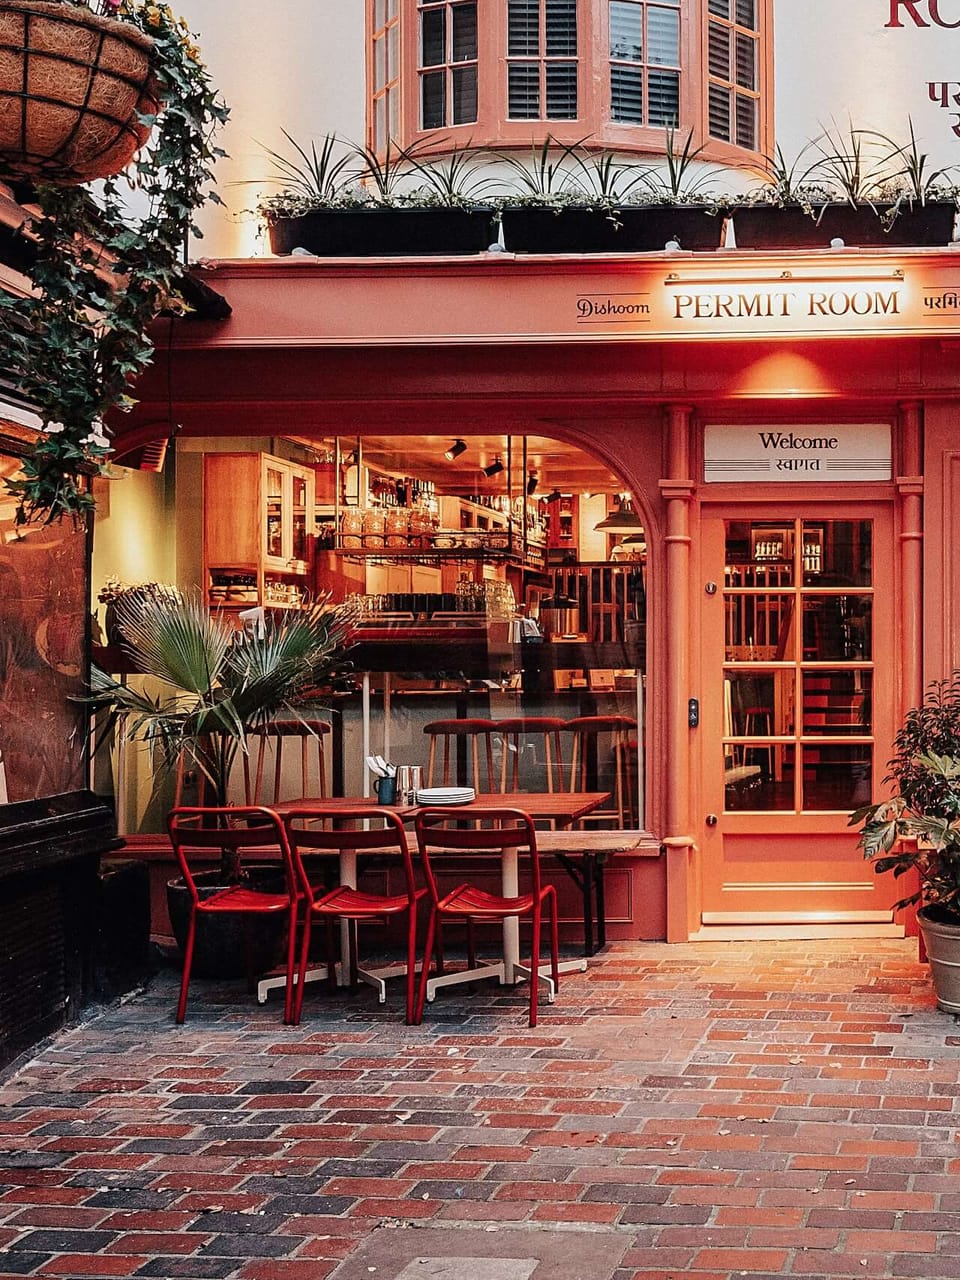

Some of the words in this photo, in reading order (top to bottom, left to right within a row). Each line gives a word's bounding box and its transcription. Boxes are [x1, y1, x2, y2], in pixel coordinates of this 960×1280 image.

[576, 298, 650, 318] Dishoom
[673, 292, 795, 319] PERMIT
[808, 290, 900, 317] ROOM
[758, 432, 838, 450] Welcome
